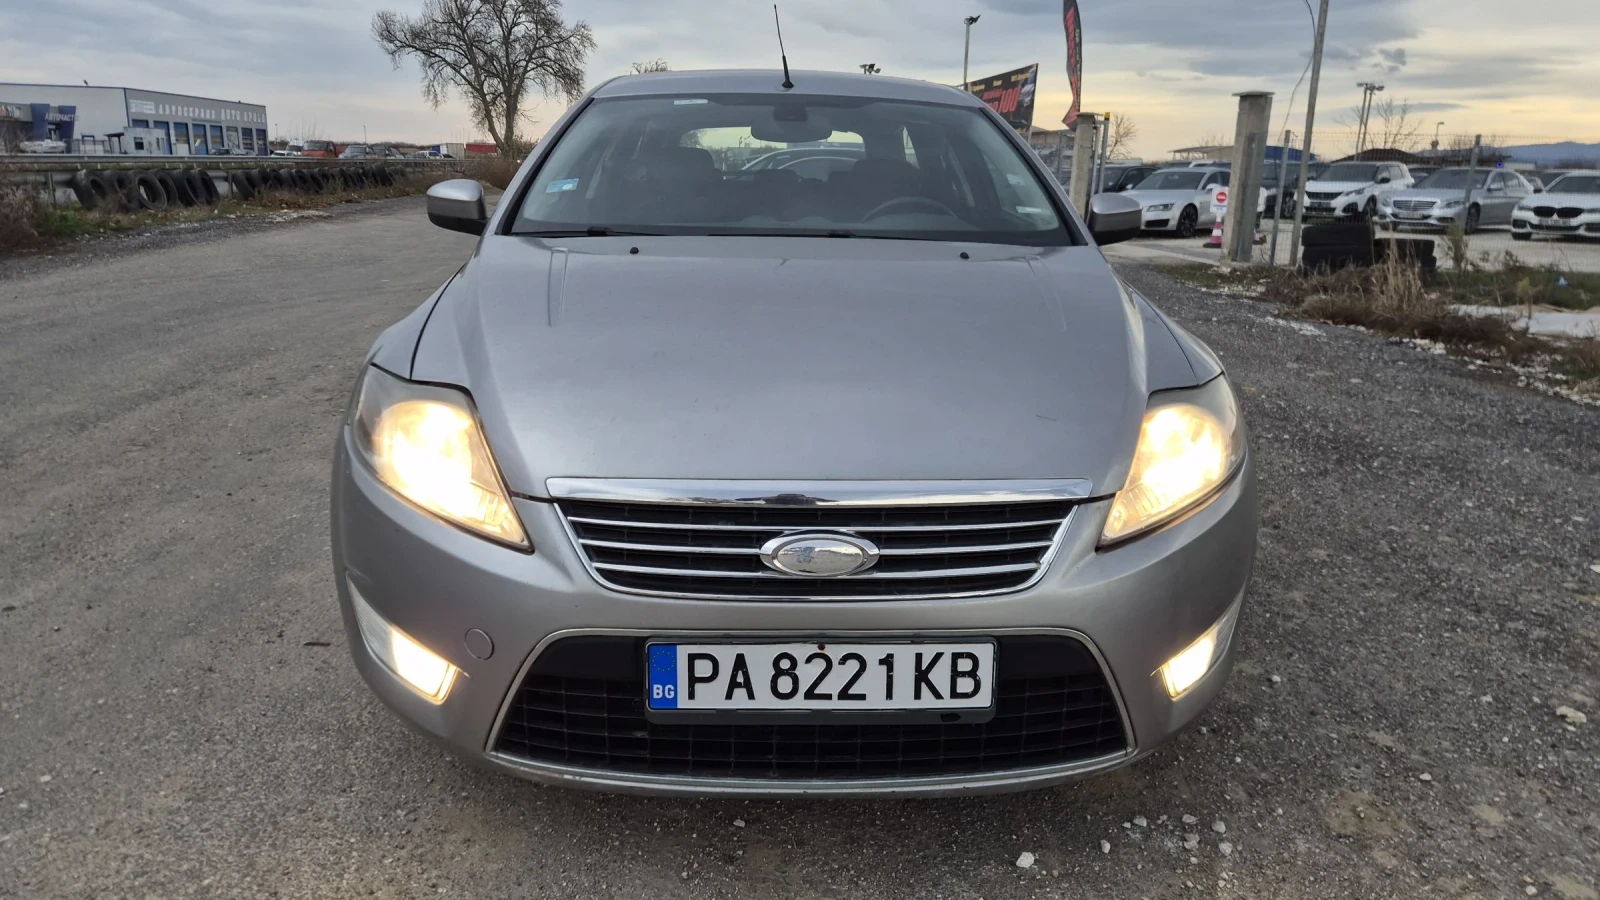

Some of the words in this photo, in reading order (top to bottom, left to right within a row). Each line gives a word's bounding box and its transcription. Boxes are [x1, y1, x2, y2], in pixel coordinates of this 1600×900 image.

[652, 684, 675, 699] BG
[687, 652, 756, 701] PA
[769, 651, 895, 701] 8221
[913, 651, 982, 700] KB
